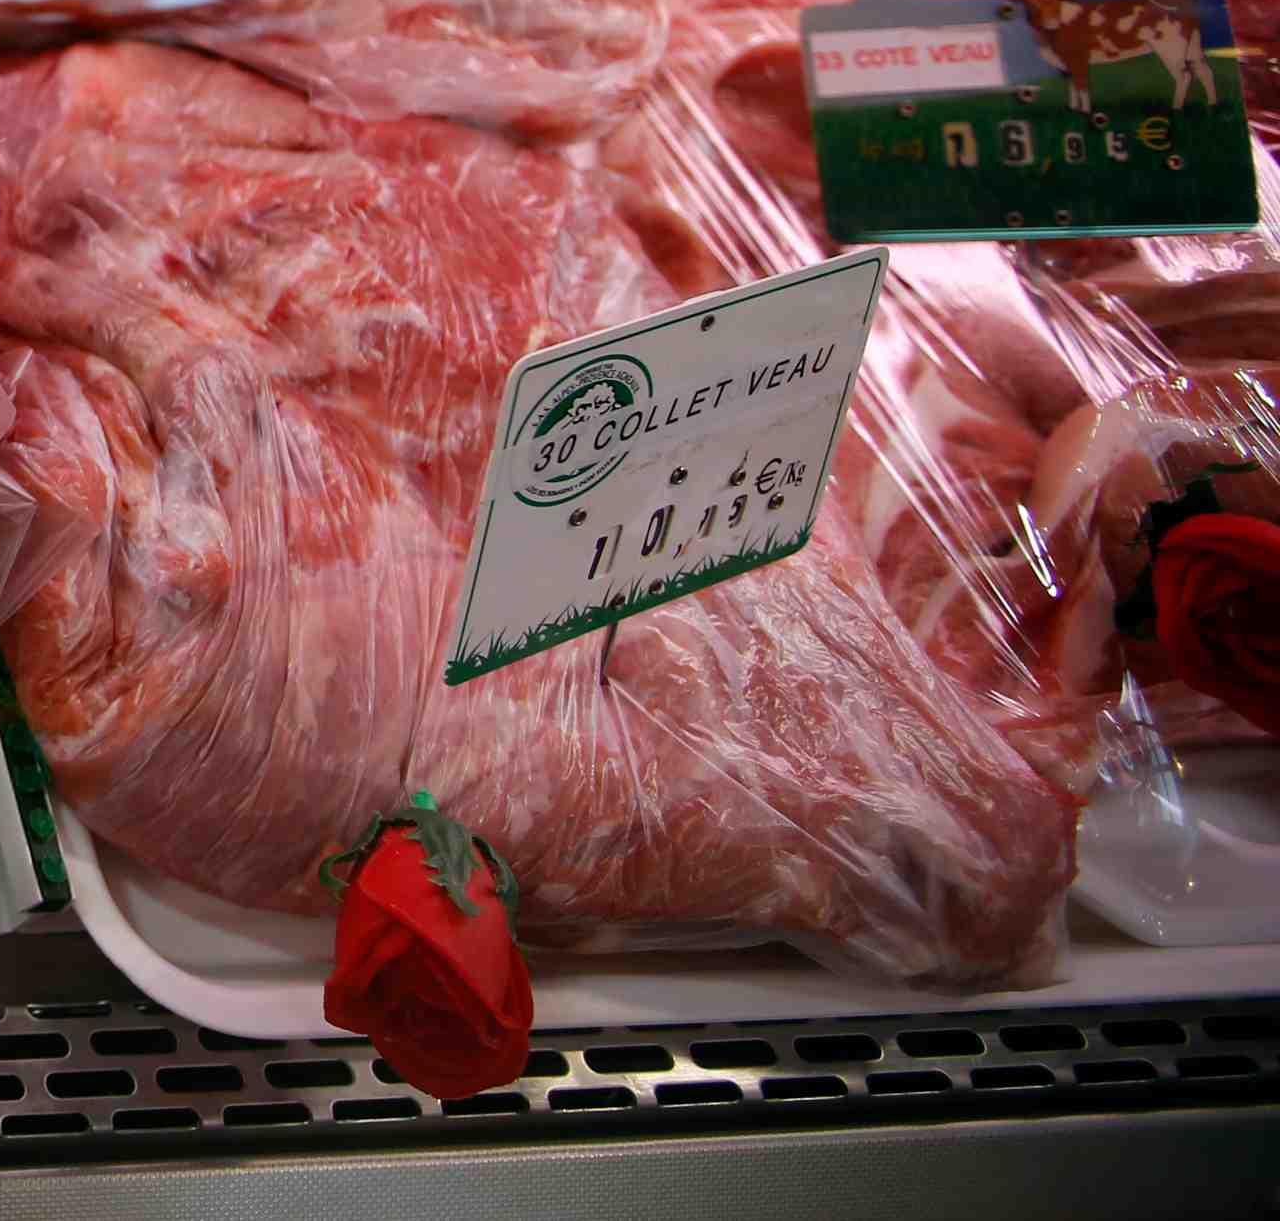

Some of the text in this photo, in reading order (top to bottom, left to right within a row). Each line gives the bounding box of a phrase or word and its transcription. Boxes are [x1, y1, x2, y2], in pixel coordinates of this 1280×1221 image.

[854, 44, 919, 69] COTE
[931, 42, 996, 65] VEAU
[533, 434, 578, 473] 30
[593, 379, 733, 450] COLLET
[747, 344, 835, 396] VEAU
